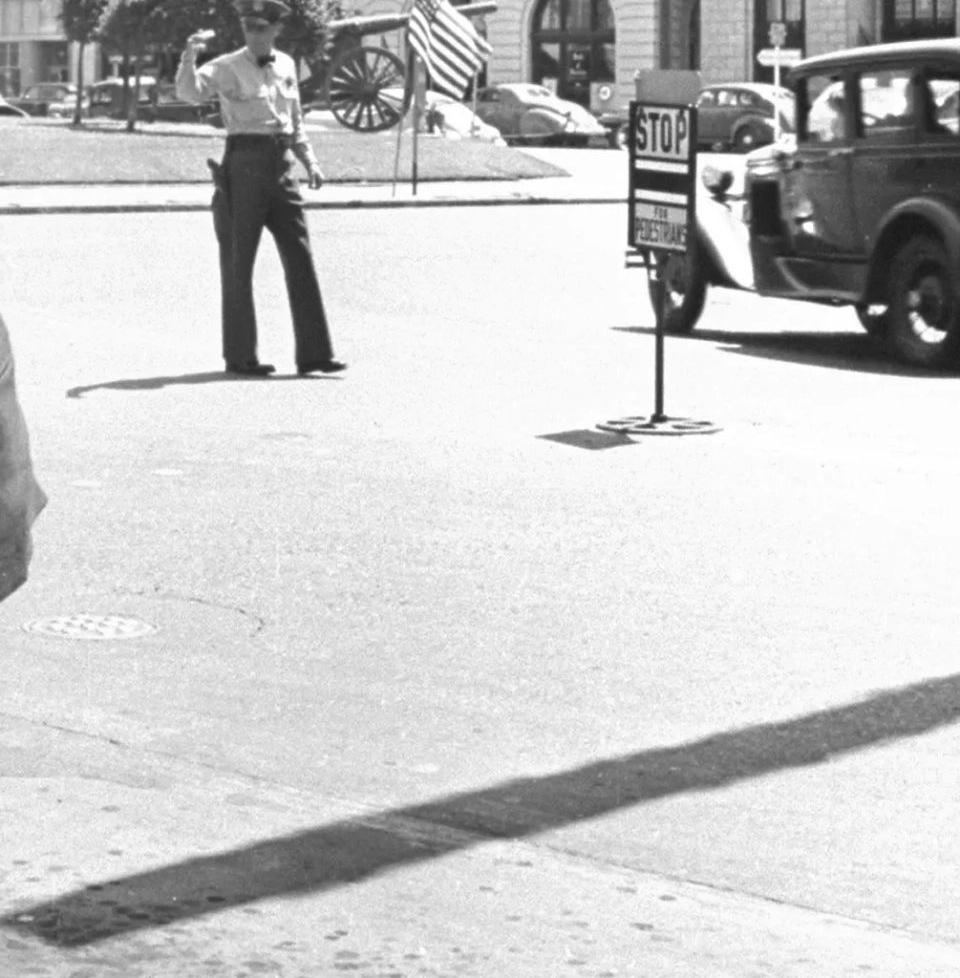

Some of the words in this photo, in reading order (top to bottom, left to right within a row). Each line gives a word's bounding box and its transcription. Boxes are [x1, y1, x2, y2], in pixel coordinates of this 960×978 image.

[637, 106, 687, 154] STOP
[654, 206, 668, 219] FOR
[635, 217, 687, 246] PEDESTRIANS
